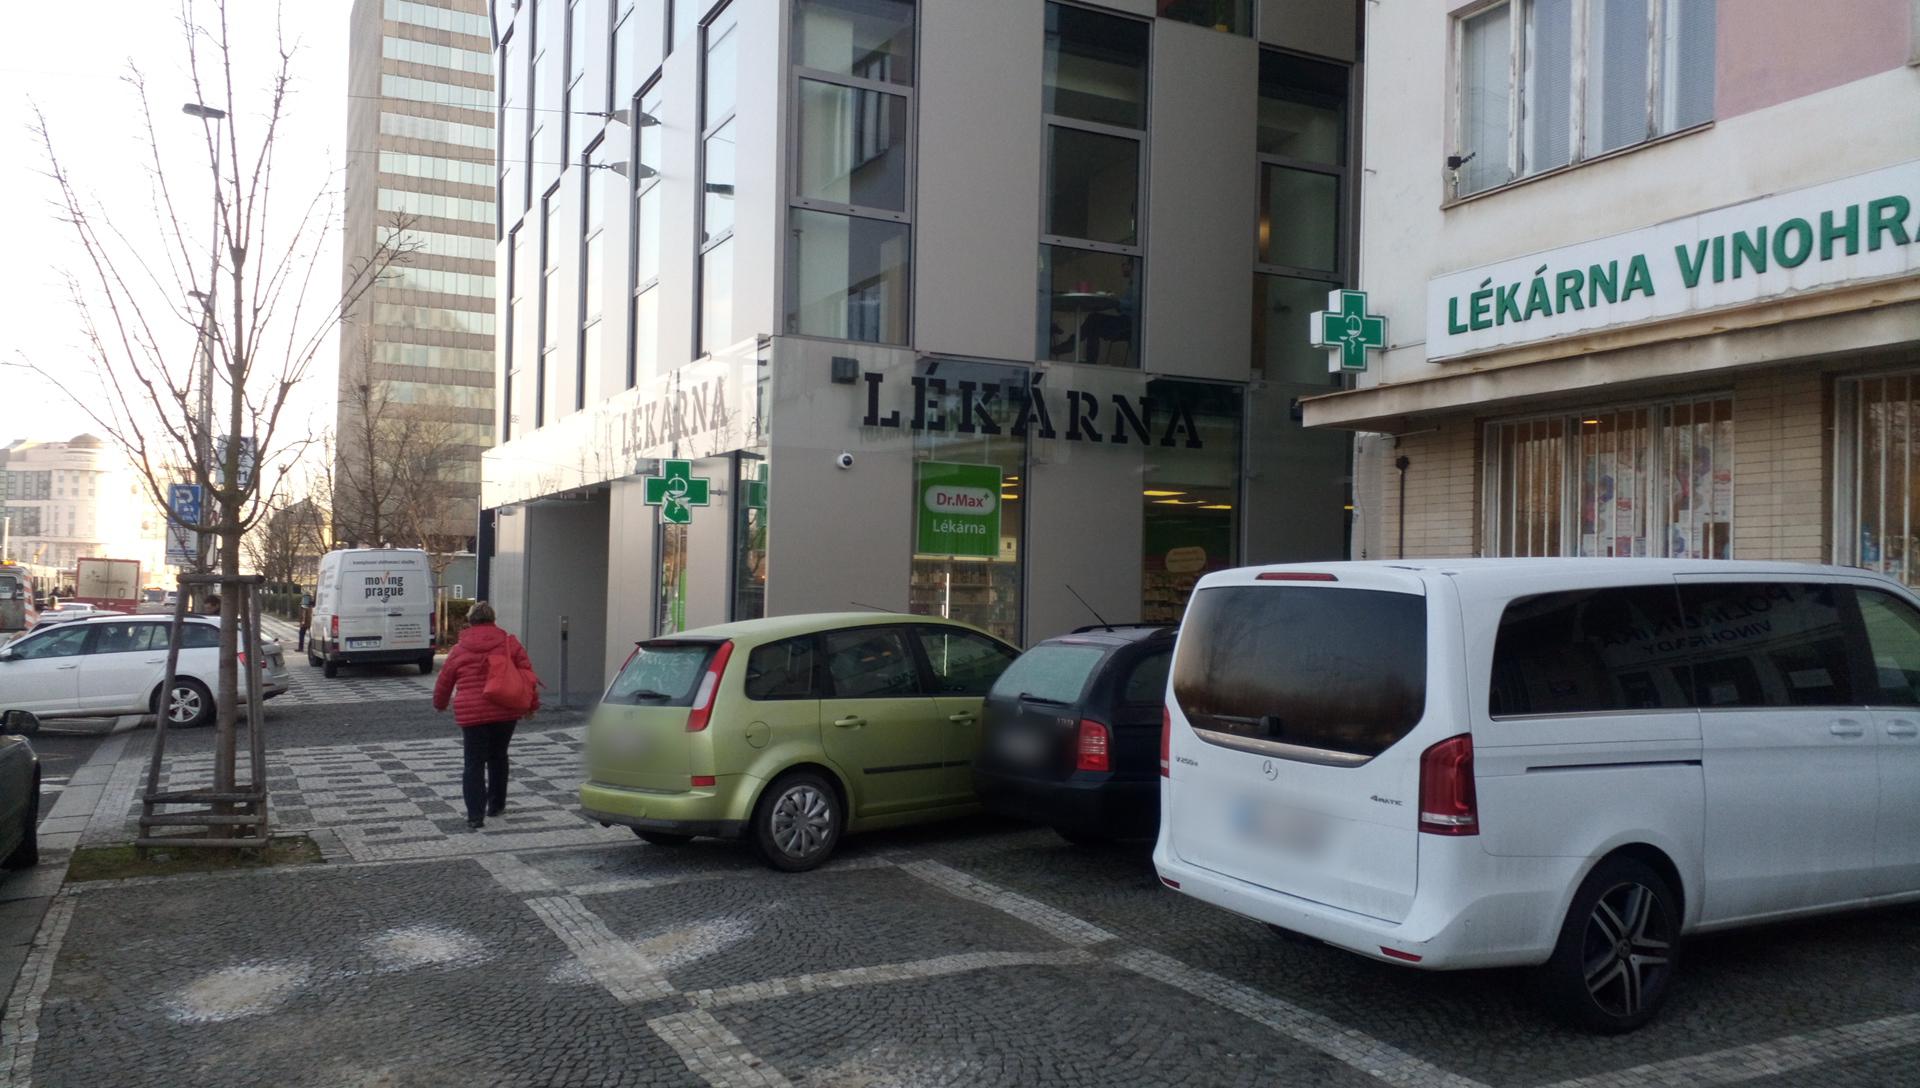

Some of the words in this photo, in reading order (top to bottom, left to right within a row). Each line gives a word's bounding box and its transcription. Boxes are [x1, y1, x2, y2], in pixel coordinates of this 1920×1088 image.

[1448, 254, 1655, 335] LÉKÁRNA
[1675, 195, 1920, 288] VINOHR
[621, 376, 728, 456] LÉKÁRNA
[863, 362, 1203, 449] LÉKÁRNA
[932, 519, 987, 534] Lékárna
[364, 571, 404, 587] moving
[364, 587, 404, 604] prague
